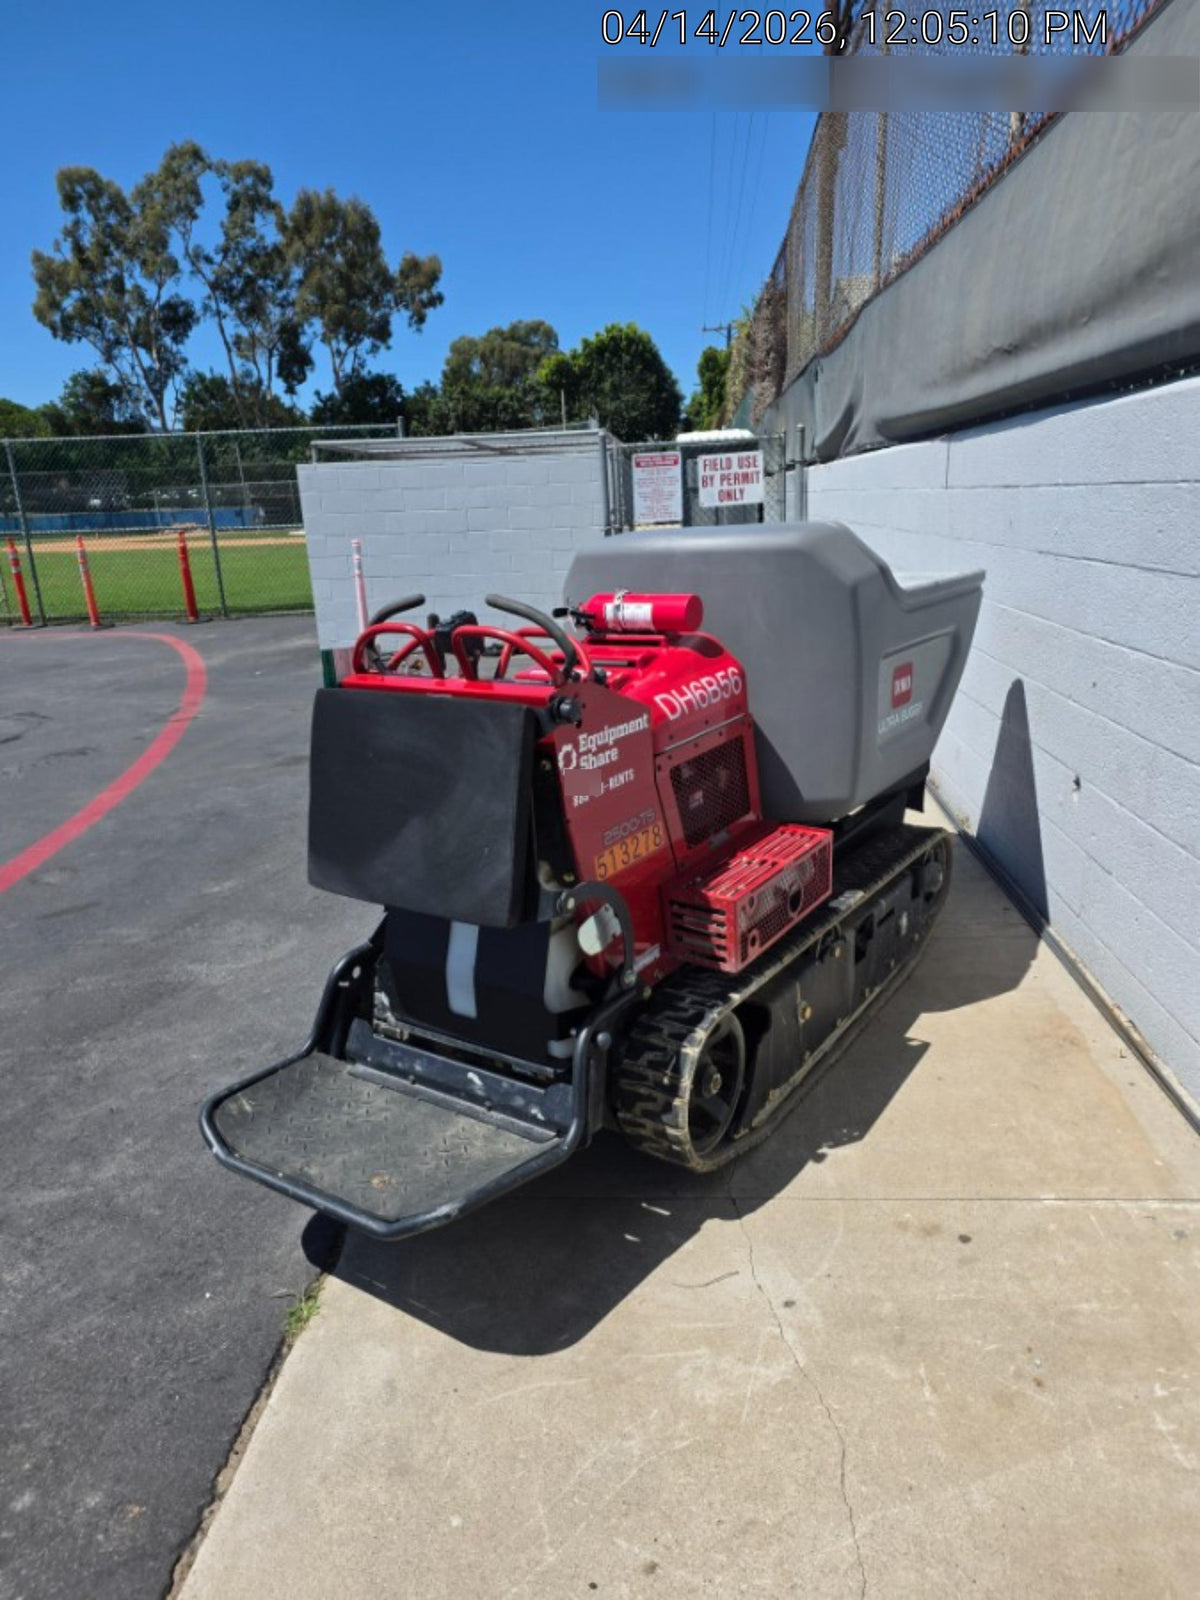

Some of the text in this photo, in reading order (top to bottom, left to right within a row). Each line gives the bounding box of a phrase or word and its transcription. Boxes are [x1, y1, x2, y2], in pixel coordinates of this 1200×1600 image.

[703, 455, 758, 472] FIELD USE
[701, 471, 760, 488] BY PERMIT
[718, 488, 745, 502] ONLY
[654, 667, 742, 720] DH6B56
[578, 713, 648, 752] Equipment
[580, 747, 618, 770] Share
[597, 824, 661, 879] 513278
